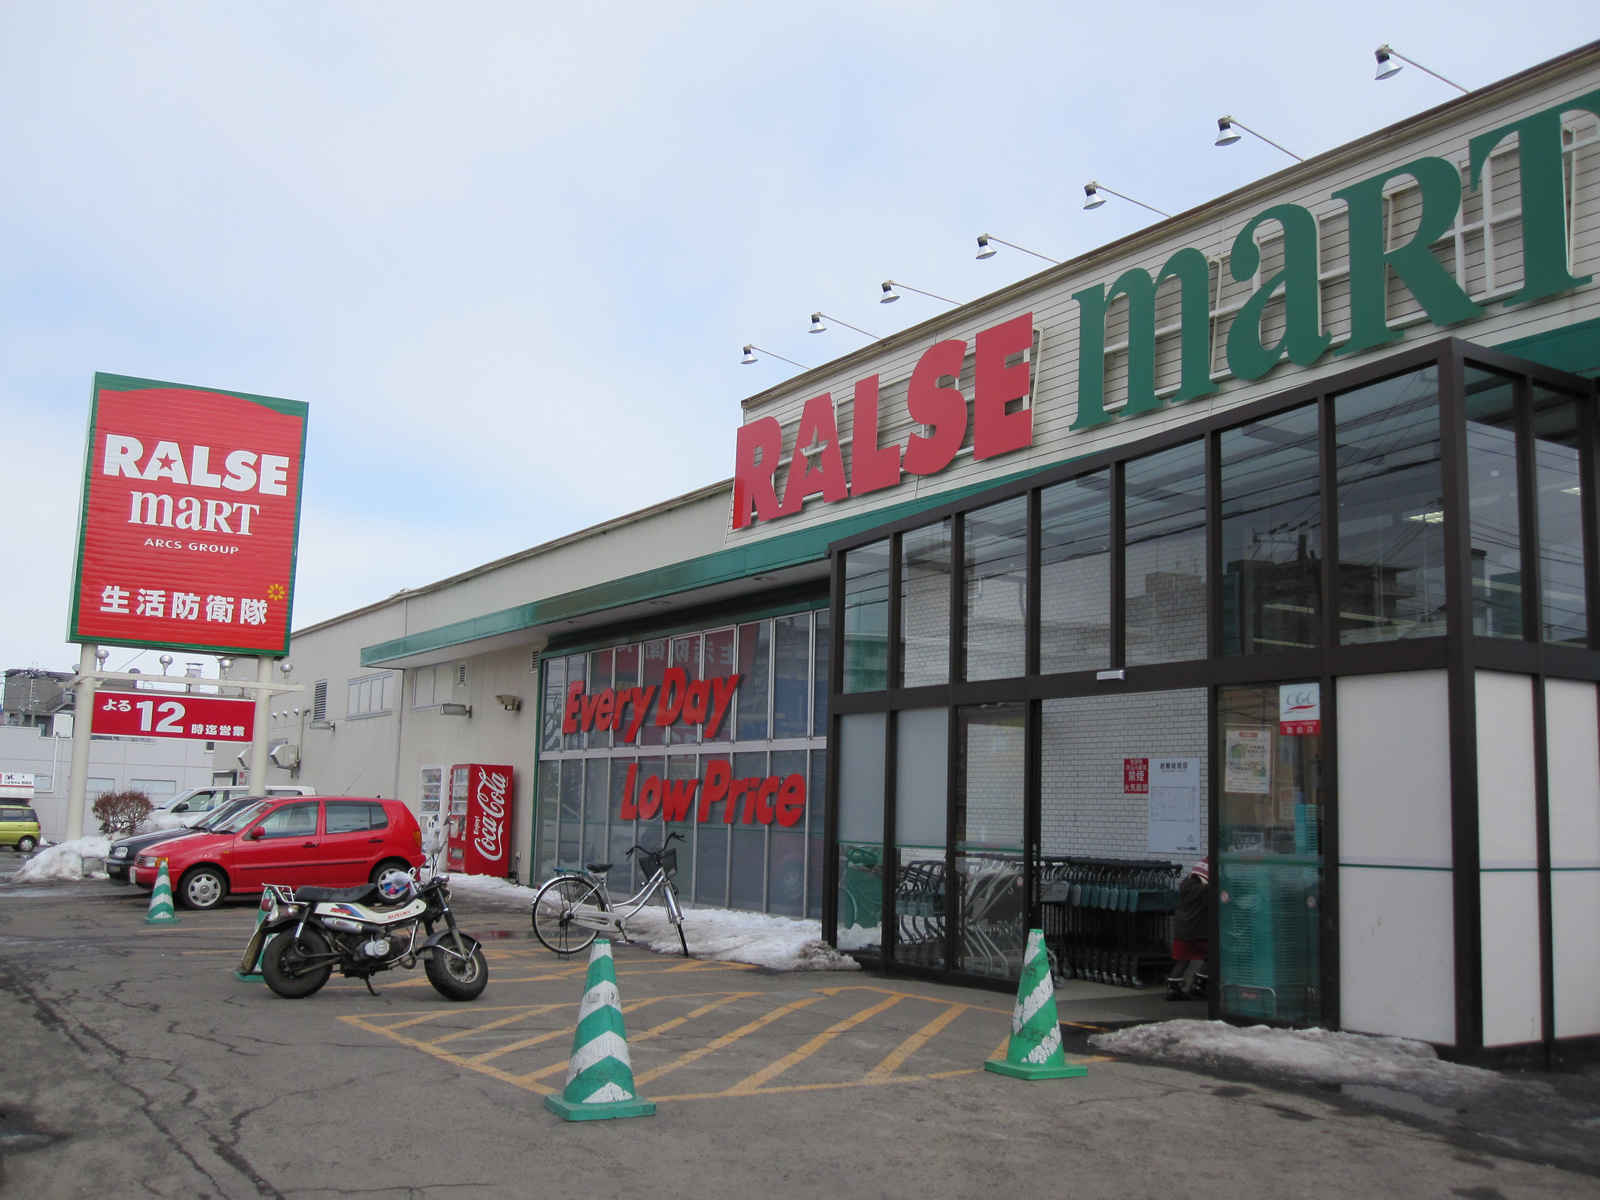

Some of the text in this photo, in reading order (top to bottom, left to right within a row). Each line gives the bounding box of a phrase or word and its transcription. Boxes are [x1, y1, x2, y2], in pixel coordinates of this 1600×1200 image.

[733, 312, 1033, 530] RALSE
[103, 433, 290, 496] RALSE
[144, 538, 239, 555] ARCS GROUP
[100, 586, 268, 626] 生活防衛隊
[562, 667, 740, 743] Every Day
[1287, 692, 1315, 706] CGC
[620, 760, 807, 827] Low Price
[1128, 770, 1145, 782] 禁煙
